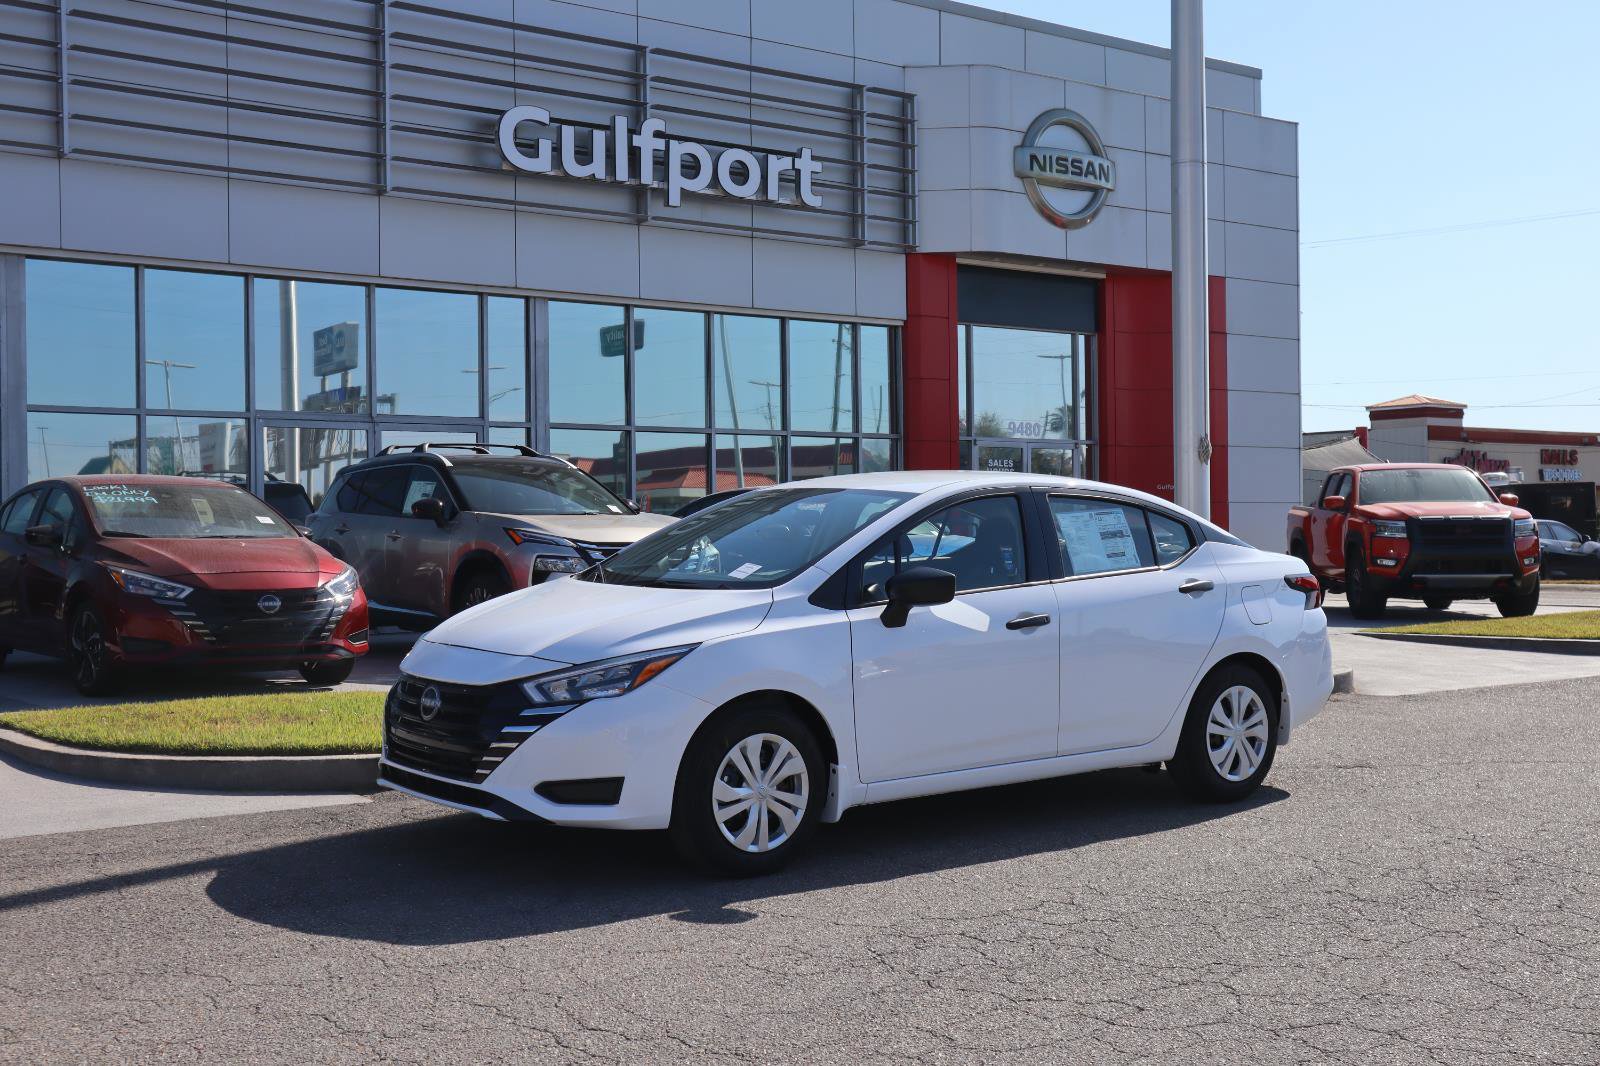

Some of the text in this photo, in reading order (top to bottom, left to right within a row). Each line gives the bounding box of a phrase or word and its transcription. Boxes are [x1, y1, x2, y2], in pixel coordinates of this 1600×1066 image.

[498, 104, 823, 207] Gulfport
[1029, 153, 1110, 183] NISSAN
[1008, 421, 1041, 437] 9480
[988, 459, 1014, 468] SALES
[1541, 449, 1578, 465] NAILS
